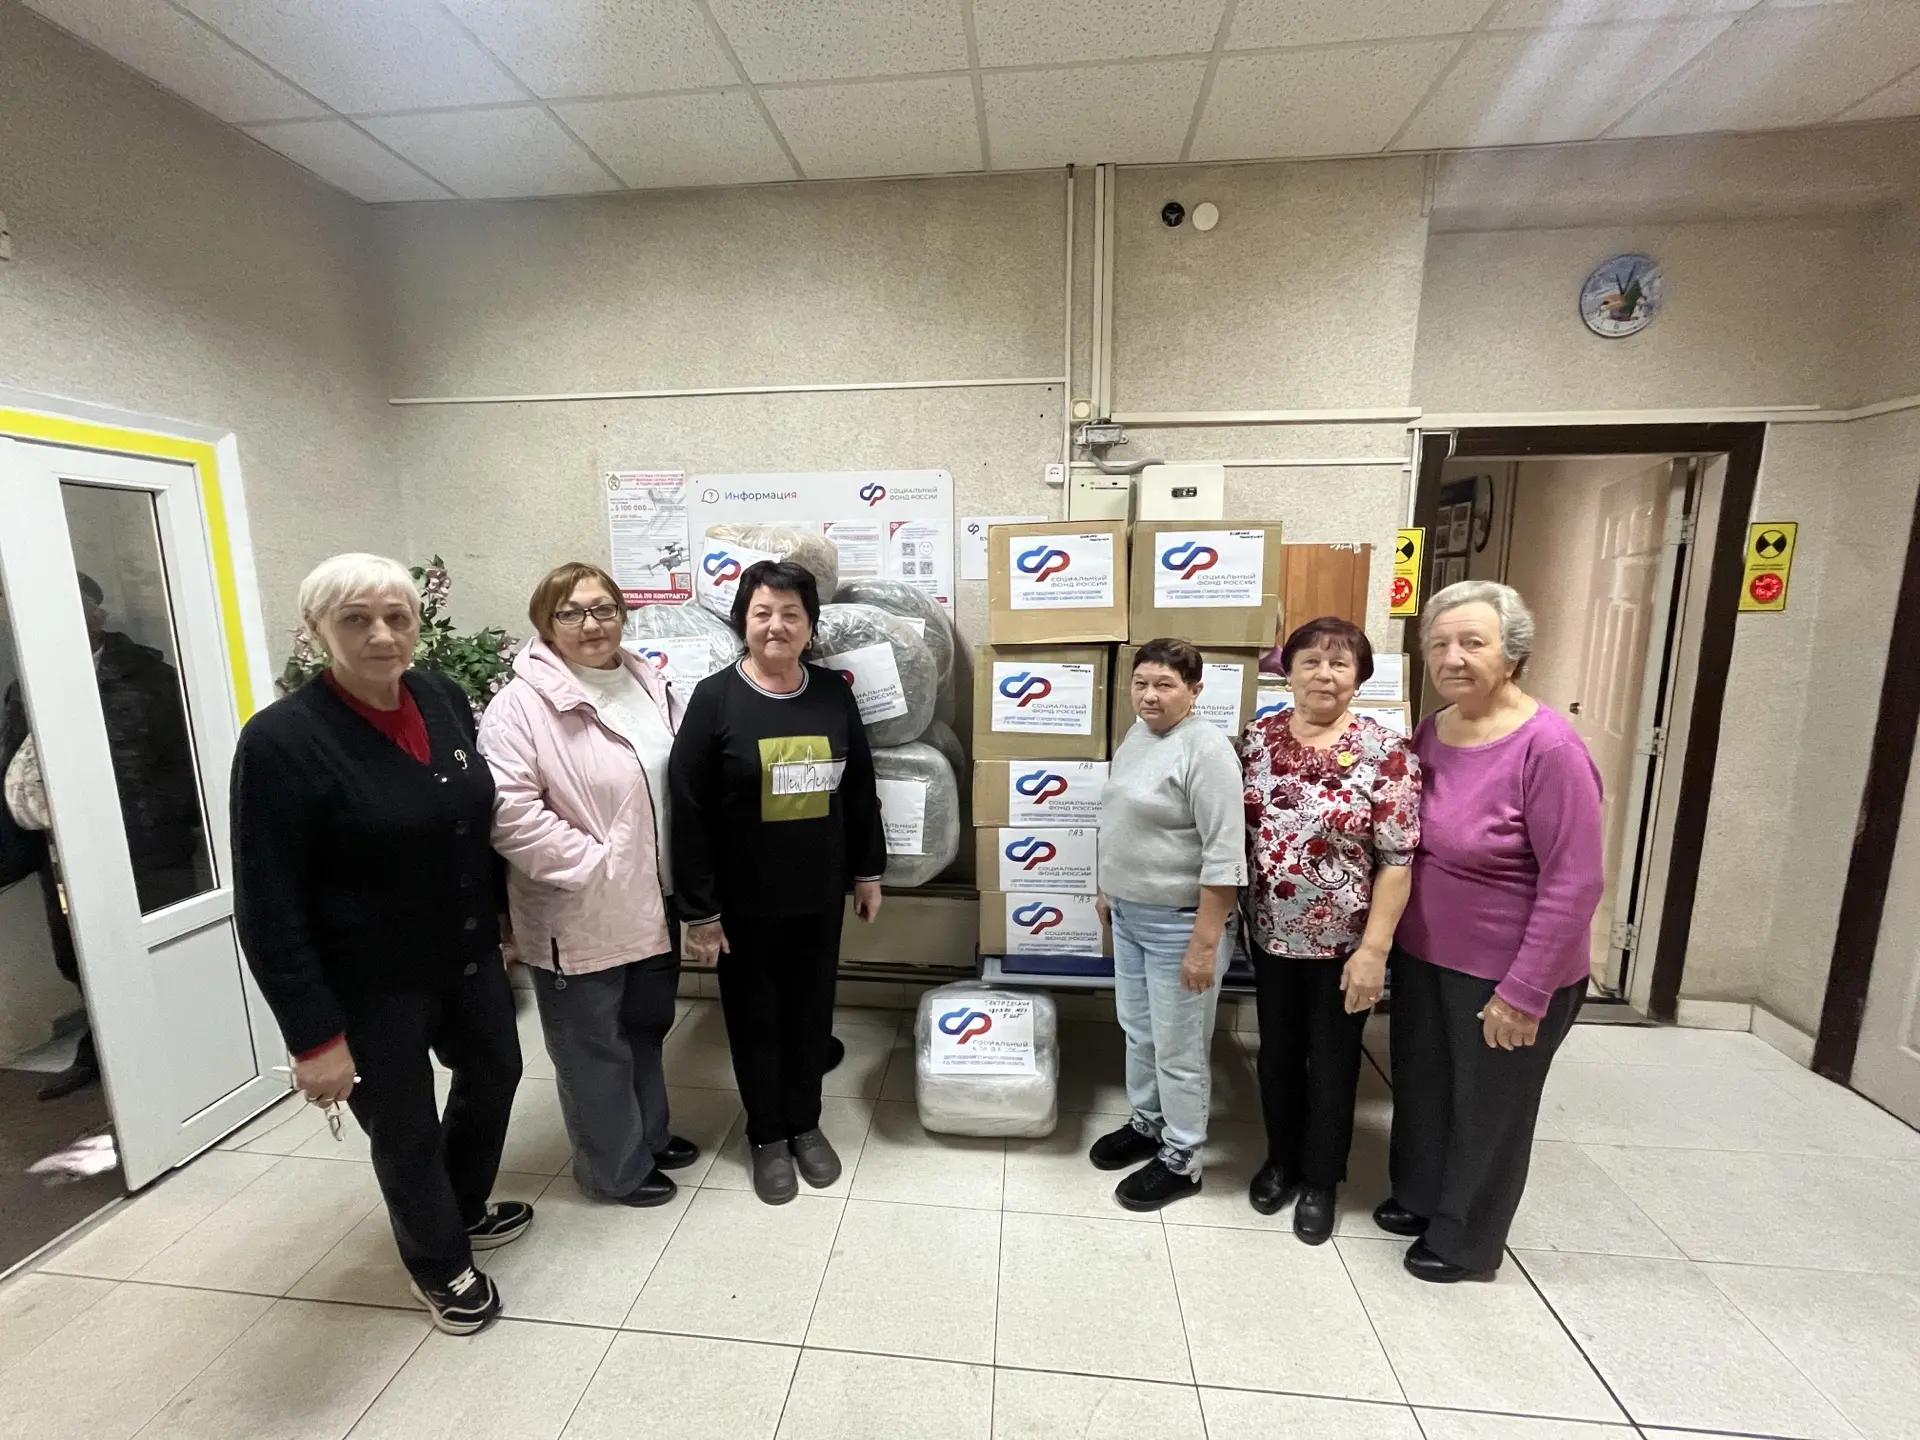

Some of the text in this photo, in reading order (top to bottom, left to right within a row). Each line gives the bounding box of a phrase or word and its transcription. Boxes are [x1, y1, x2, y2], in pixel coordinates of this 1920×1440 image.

[724, 490, 797, 501] Информация
[856, 684, 896, 698] ИАЛЬНЫЙ
[866, 690, 897, 702] РОССИИ
